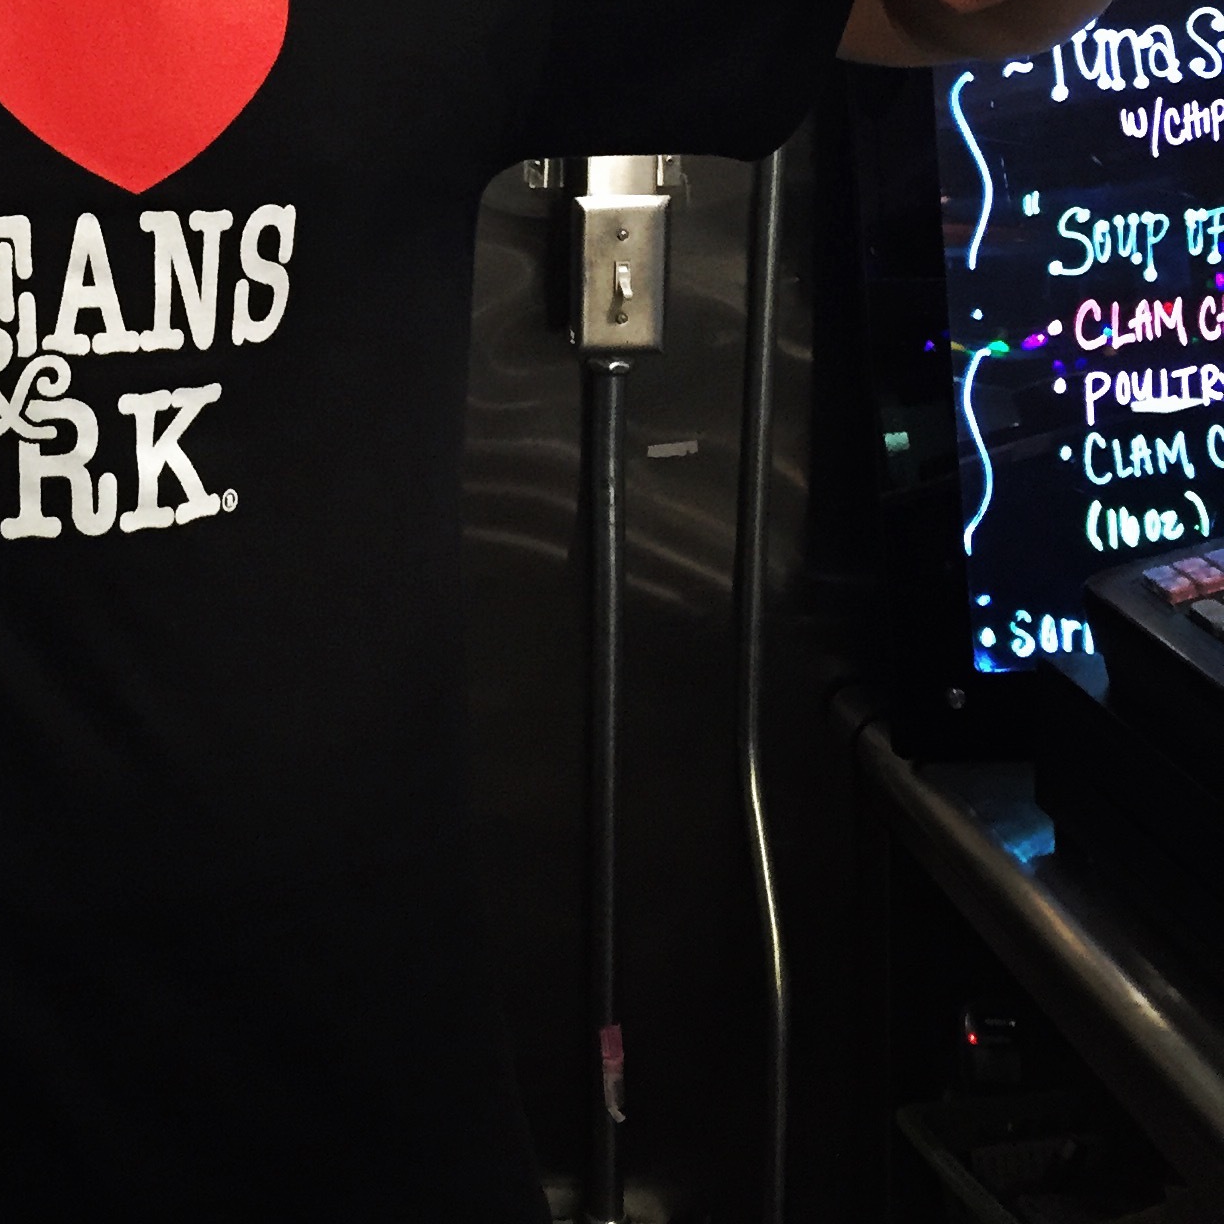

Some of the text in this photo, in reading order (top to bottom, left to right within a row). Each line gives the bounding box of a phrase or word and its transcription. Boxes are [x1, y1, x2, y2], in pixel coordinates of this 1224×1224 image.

[1075, 296, 1188, 351] CLAM
[1084, 363, 1224, 426] POULTR
[1084, 430, 1195, 485] CLAM
